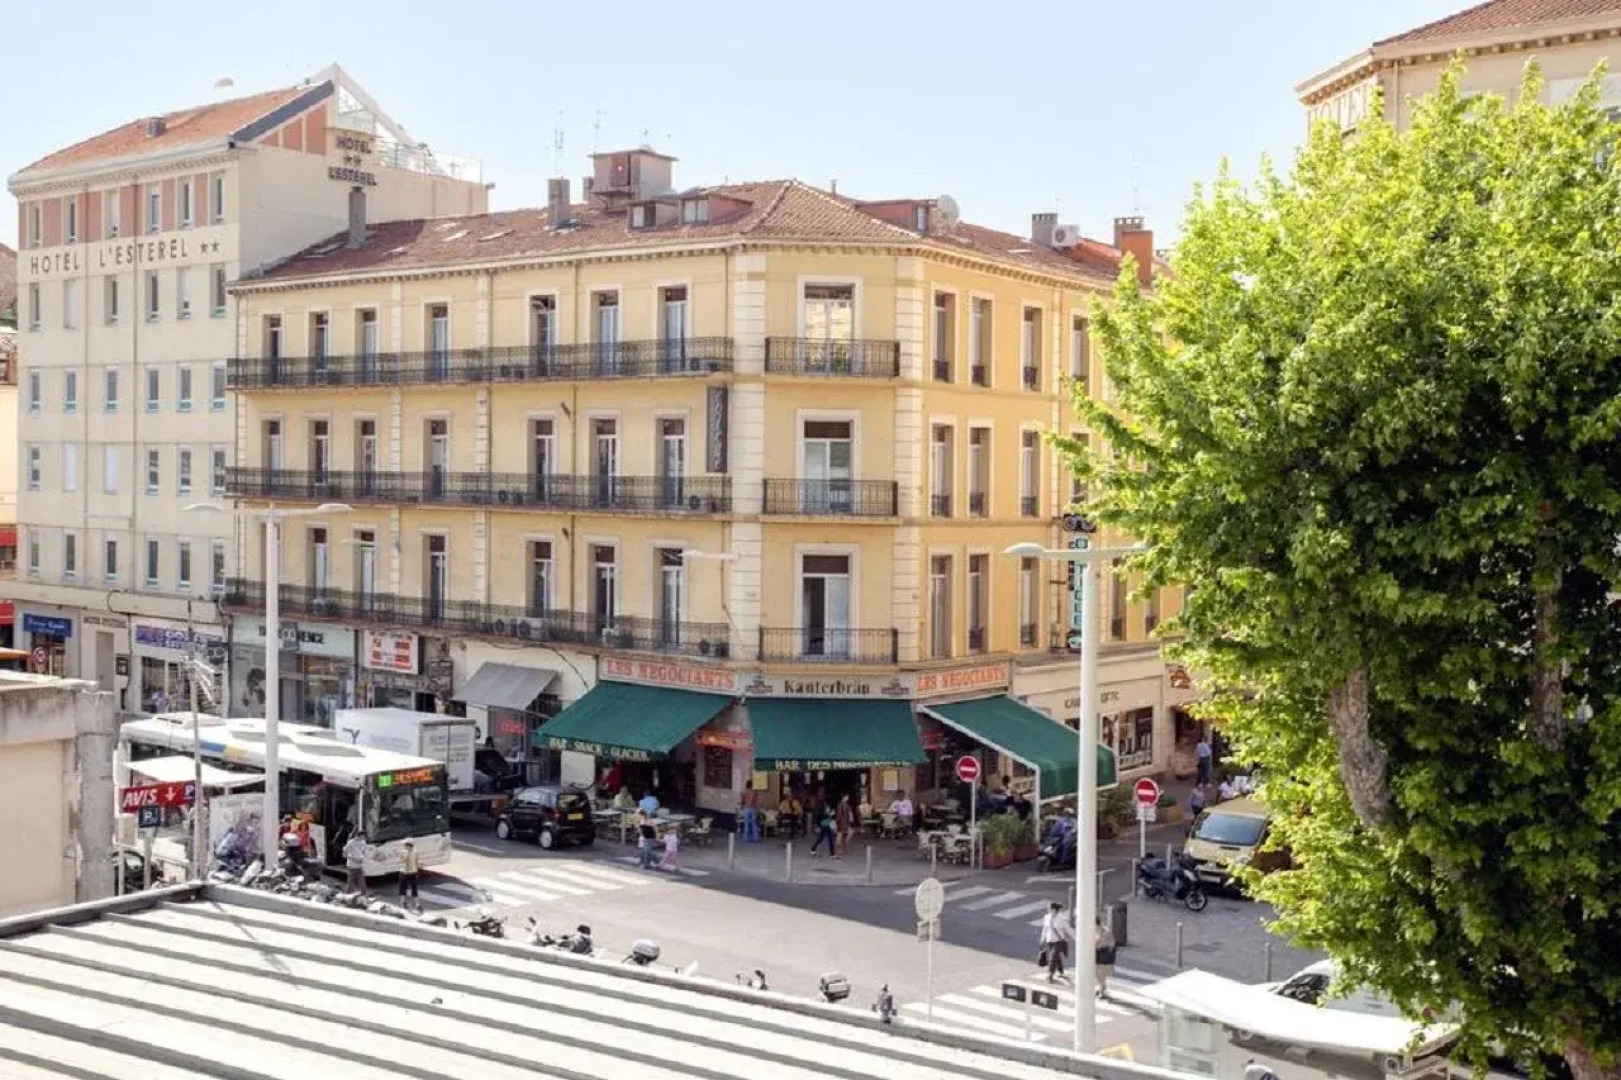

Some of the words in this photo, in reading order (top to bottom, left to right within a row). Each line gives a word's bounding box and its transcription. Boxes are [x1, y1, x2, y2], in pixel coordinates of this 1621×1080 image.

[336, 136, 371, 153] HOTEL
[30, 251, 79, 275] HOTEL
[100, 239, 188, 267] L'ESTEREL
[607, 660, 632, 676] LES
[918, 674, 937, 691] LES
[122, 788, 157, 807] AVIS
